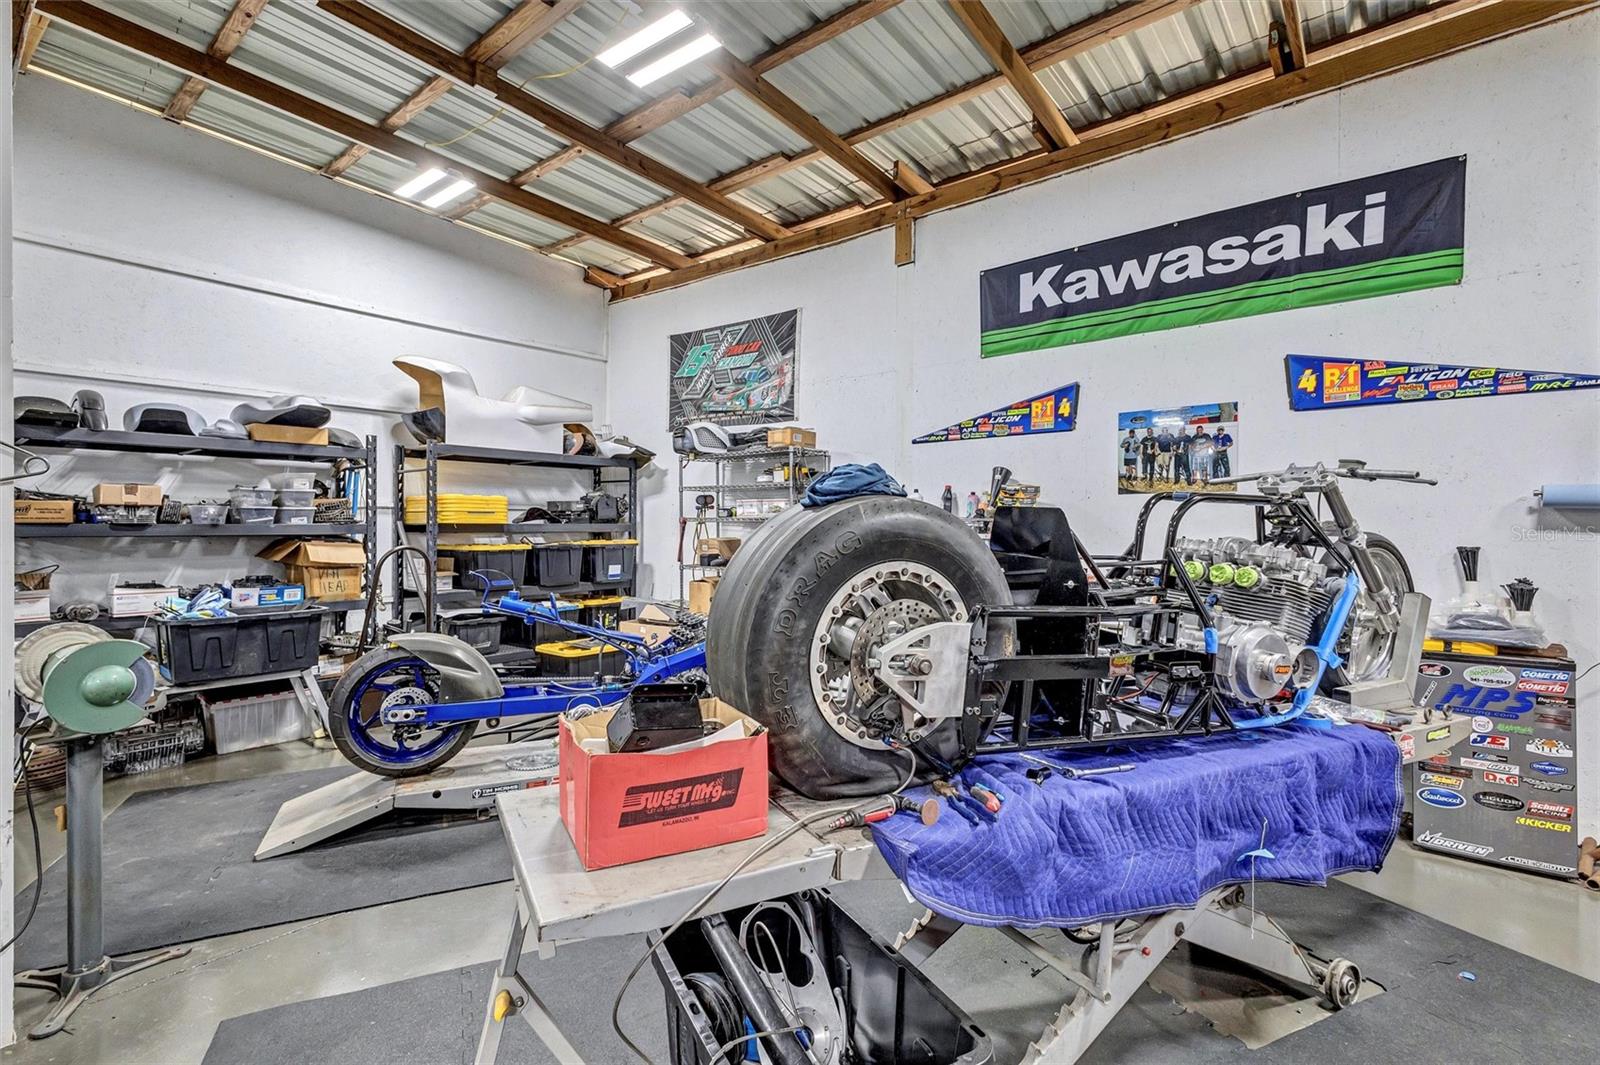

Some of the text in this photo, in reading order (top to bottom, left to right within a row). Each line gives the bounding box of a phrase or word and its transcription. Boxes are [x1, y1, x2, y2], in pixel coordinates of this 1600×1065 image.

[1019, 191, 1387, 314] Kawasaki
[1298, 369, 1318, 393] 4
[1057, 397, 1073, 418] 4
[774, 530, 864, 638] DRAG
[1522, 670, 1569, 680] COMETIC
[1518, 682, 1565, 693] COMETIC
[1440, 683, 1536, 714] MPS
[1471, 734, 1507, 747] JE
[630, 786, 692, 812] SWEET
[1421, 790, 1462, 804] Eastwood
[1530, 801, 1570, 813] Schnitz
[1526, 819, 1572, 833] KICKER
[1432, 839, 1488, 855] DRIVEN
